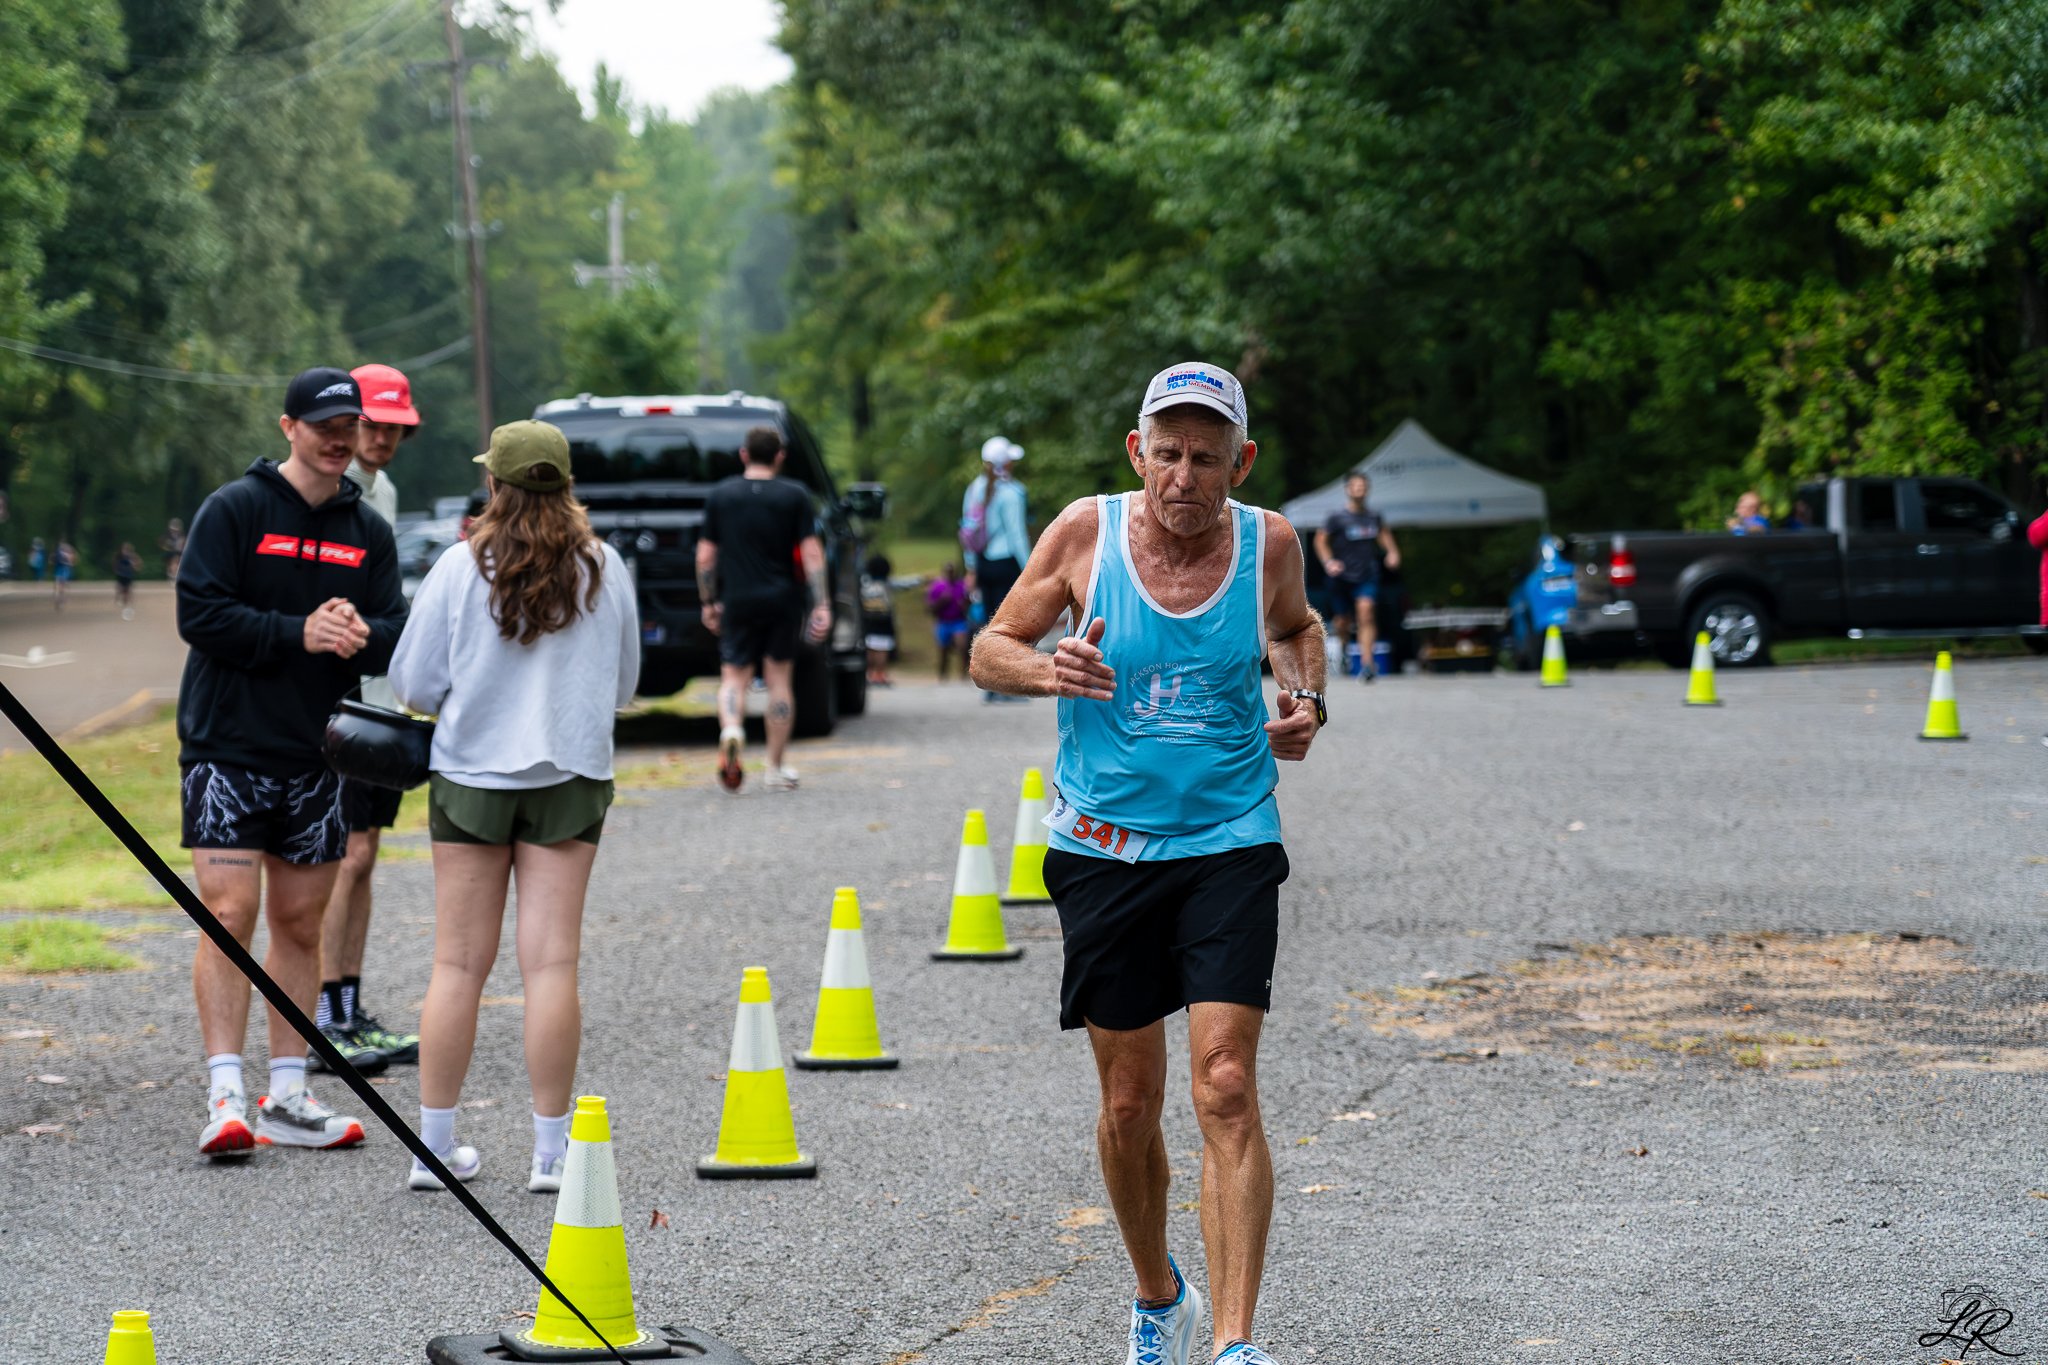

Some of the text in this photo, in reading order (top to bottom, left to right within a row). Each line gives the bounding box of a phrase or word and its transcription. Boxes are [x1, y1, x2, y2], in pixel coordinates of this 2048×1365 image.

[1167, 371, 1224, 390] IRONMAN
[1167, 380, 1188, 391] 70.3
[1128, 662, 1214, 712] JACKSON HOLE MARATON
[1072, 814, 1130, 855] 541
